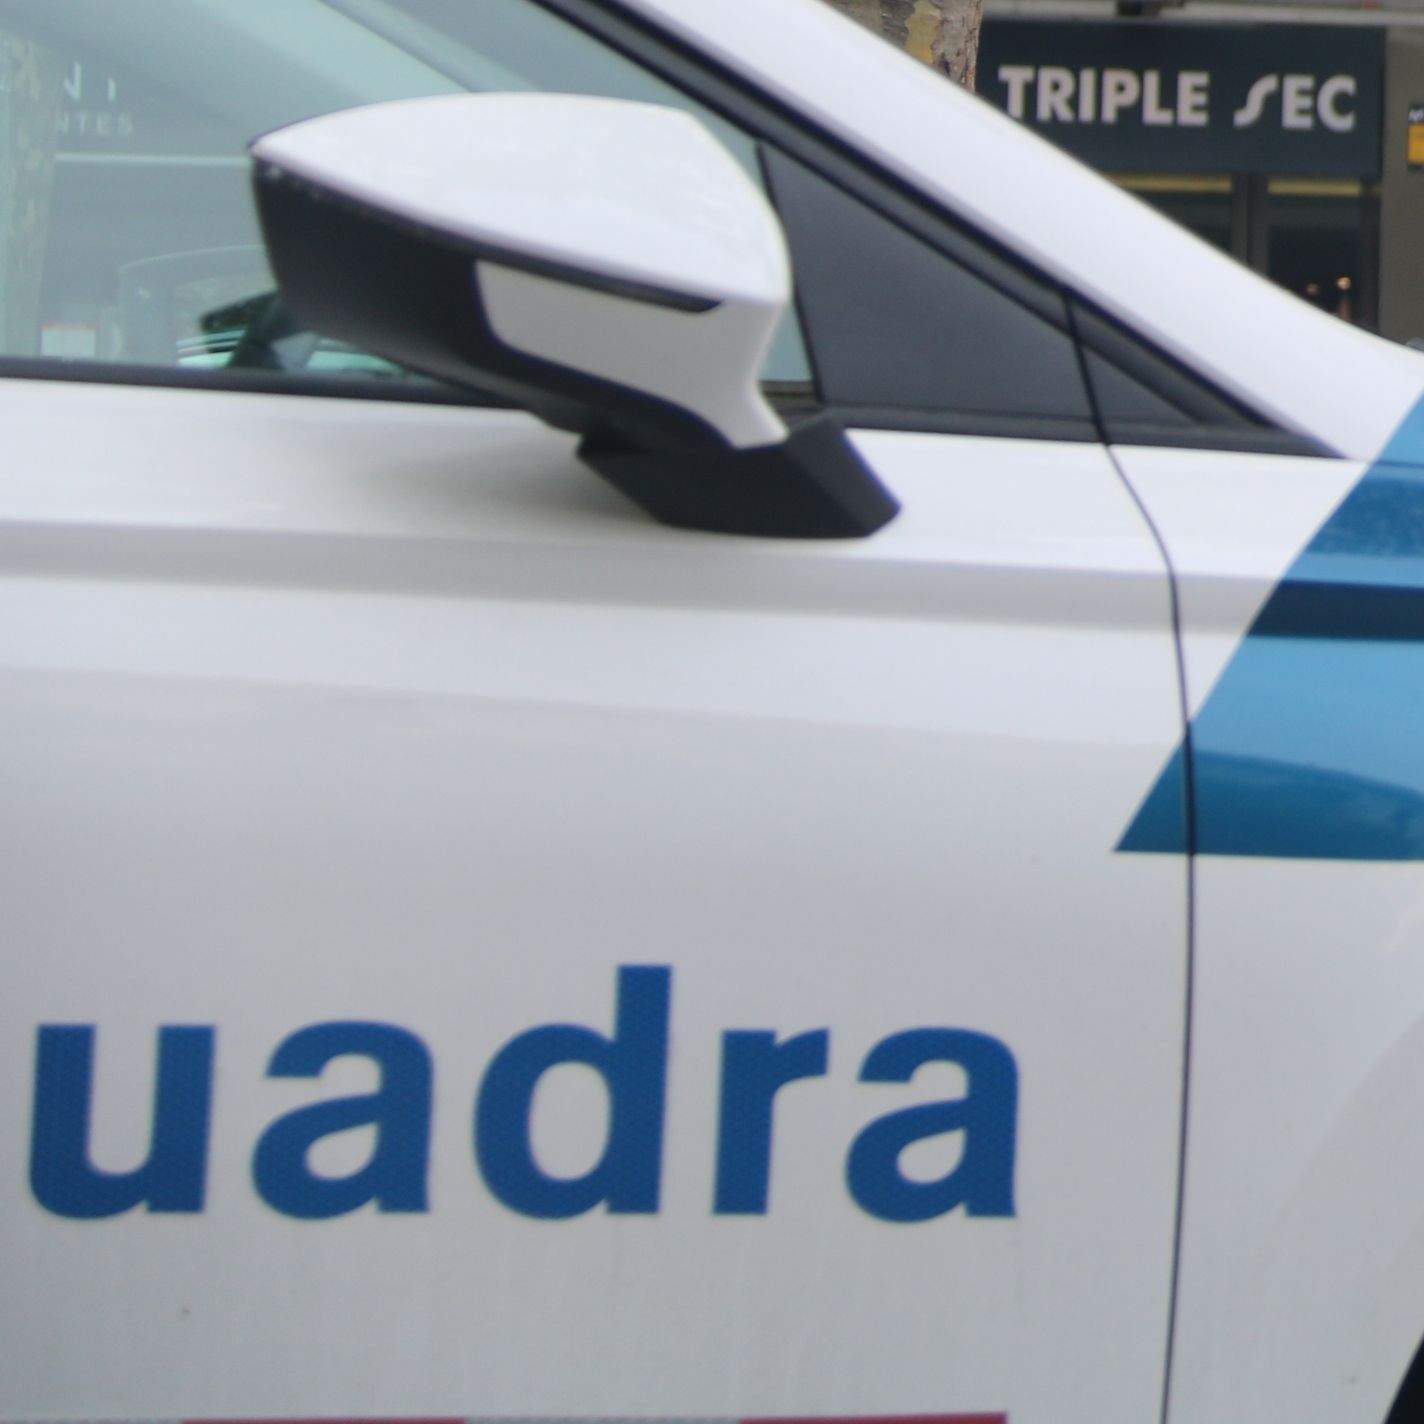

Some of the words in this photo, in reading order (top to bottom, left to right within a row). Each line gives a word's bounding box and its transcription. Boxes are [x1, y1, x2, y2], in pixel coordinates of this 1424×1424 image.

[999, 65, 1210, 127] TRIPLE
[1232, 74, 1357, 133] SEC
[28, 963, 1020, 1224] uadra
